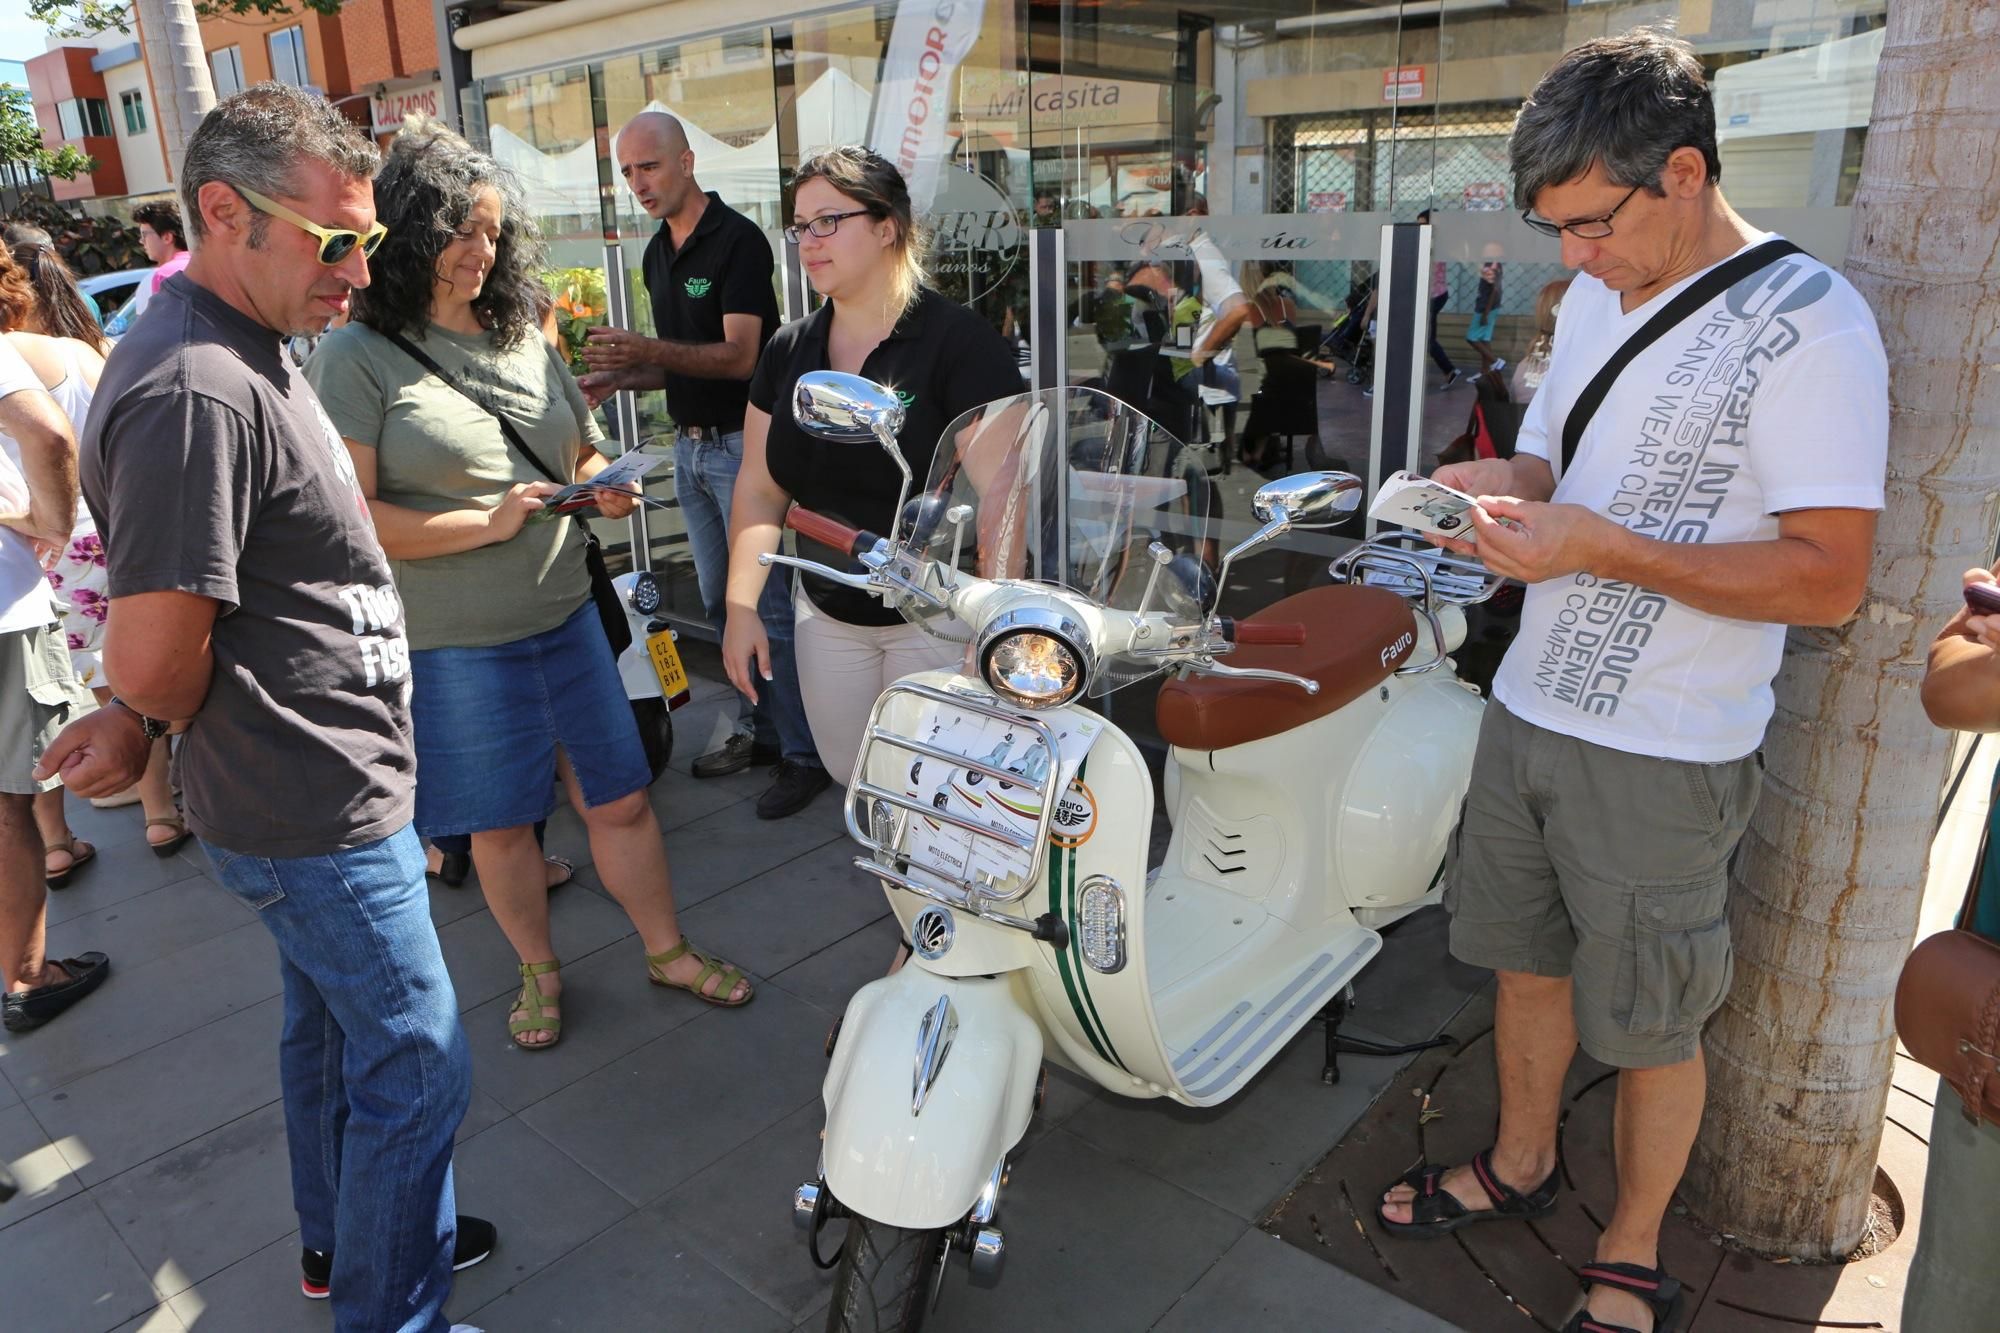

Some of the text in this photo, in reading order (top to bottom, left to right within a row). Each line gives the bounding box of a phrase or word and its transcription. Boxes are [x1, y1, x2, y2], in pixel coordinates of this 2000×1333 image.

[376, 90, 437, 126] CALZADOS
[1034, 82, 1120, 112] casita
[688, 277, 708, 285] Fauro
[1666, 310, 1736, 387] JEANS
[1713, 316, 1801, 447] FLASH
[1629, 395, 1684, 468] WEAR
[338, 584, 399, 636] The
[656, 641, 668, 656] C2
[1381, 631, 1412, 668] Fauro
[1533, 593, 1587, 697] COMPANY
[659, 655, 676, 672] 182
[1553, 630, 1602, 704] DENIM
[1059, 799, 1083, 813] auro
[928, 845, 941, 858] MOTO
